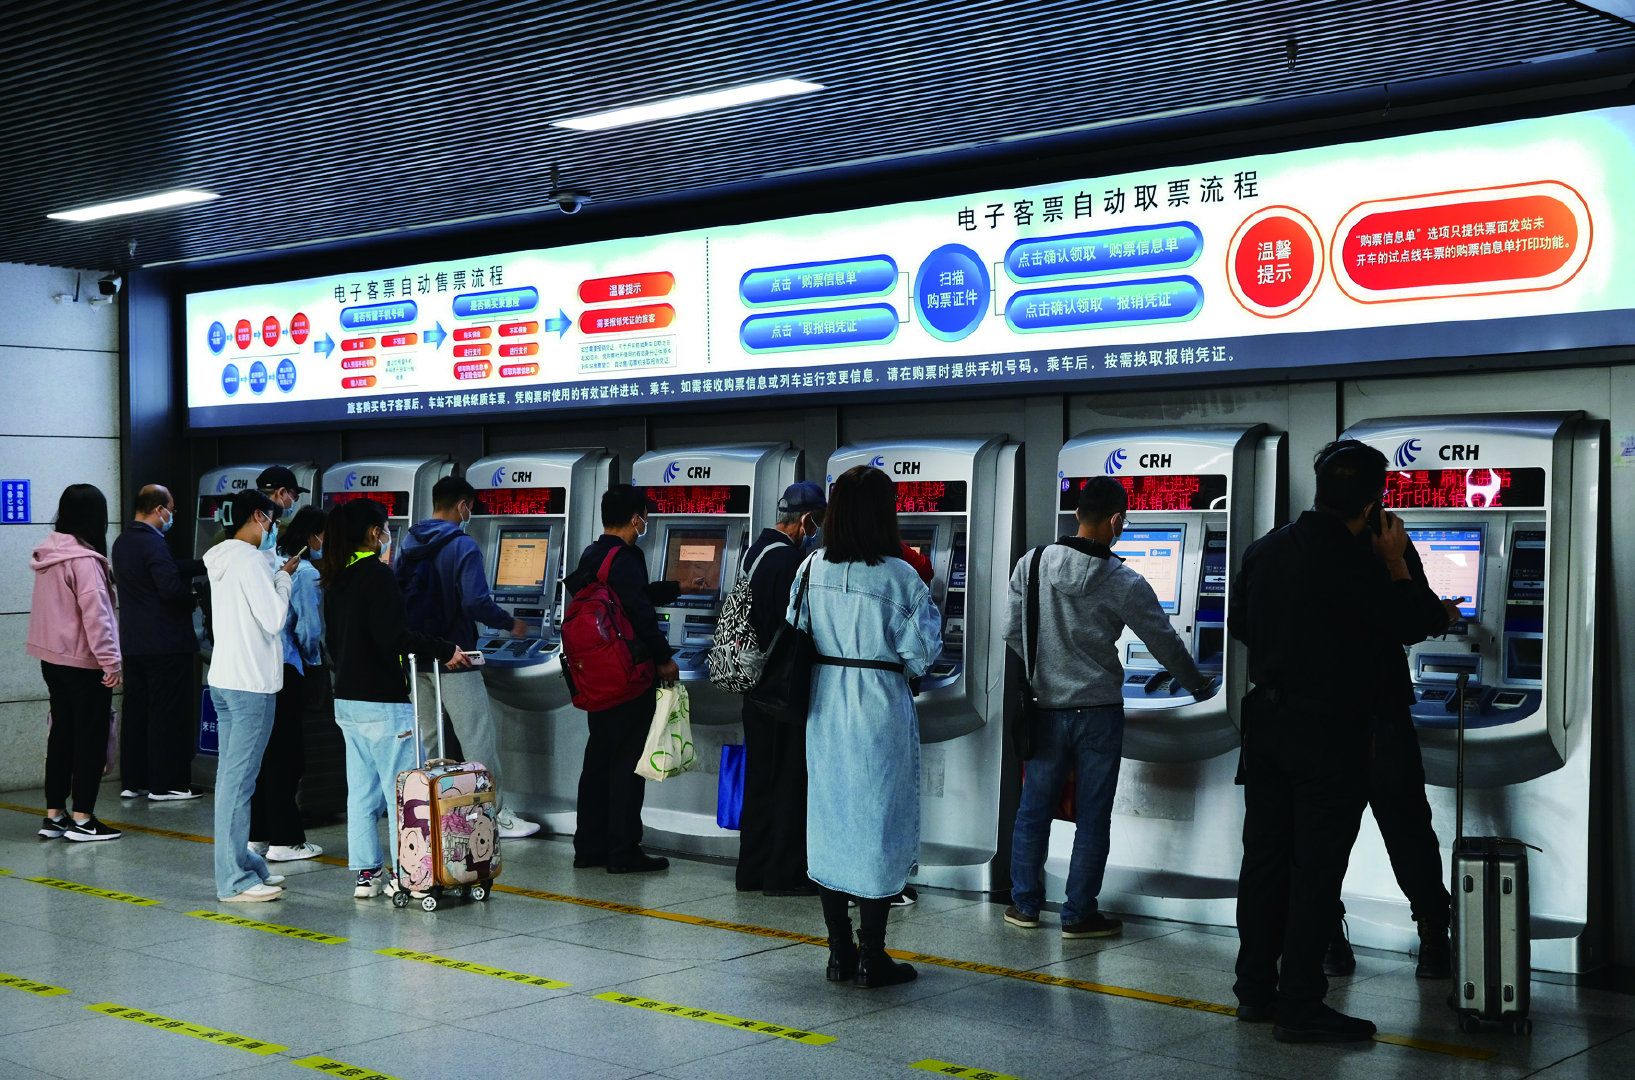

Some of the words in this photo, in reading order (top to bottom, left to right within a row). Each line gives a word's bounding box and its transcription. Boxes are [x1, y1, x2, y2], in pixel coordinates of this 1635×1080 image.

[957, 171, 1259, 232] 电子客票自动取票流程
[1257, 240, 1292, 261] 温馨
[1355, 235, 1570, 267] 开车的试点线车票的购票信息单打印功能。
[939, 270, 965, 287] 扫描
[1257, 263, 1292, 285] 提示
[334, 264, 505, 304] 电子客票自动售票流程
[609, 282, 642, 297] 温馨提示
[927, 290, 979, 309] 购票证件
[596, 313, 656, 329] 需要报销凭证的旅客
[1438, 443, 1480, 461] CRH
[893, 461, 921, 475] CRH
[1139, 453, 1172, 468] CRH
[511, 471, 532, 483] CRH
[687, 466, 711, 479] CRH
[231, 479, 248, 490] CRH
[360, 475, 379, 487] CRH
[1062, 480, 1070, 490] 18
[1143, 475, 1200, 493] 刷证进站
